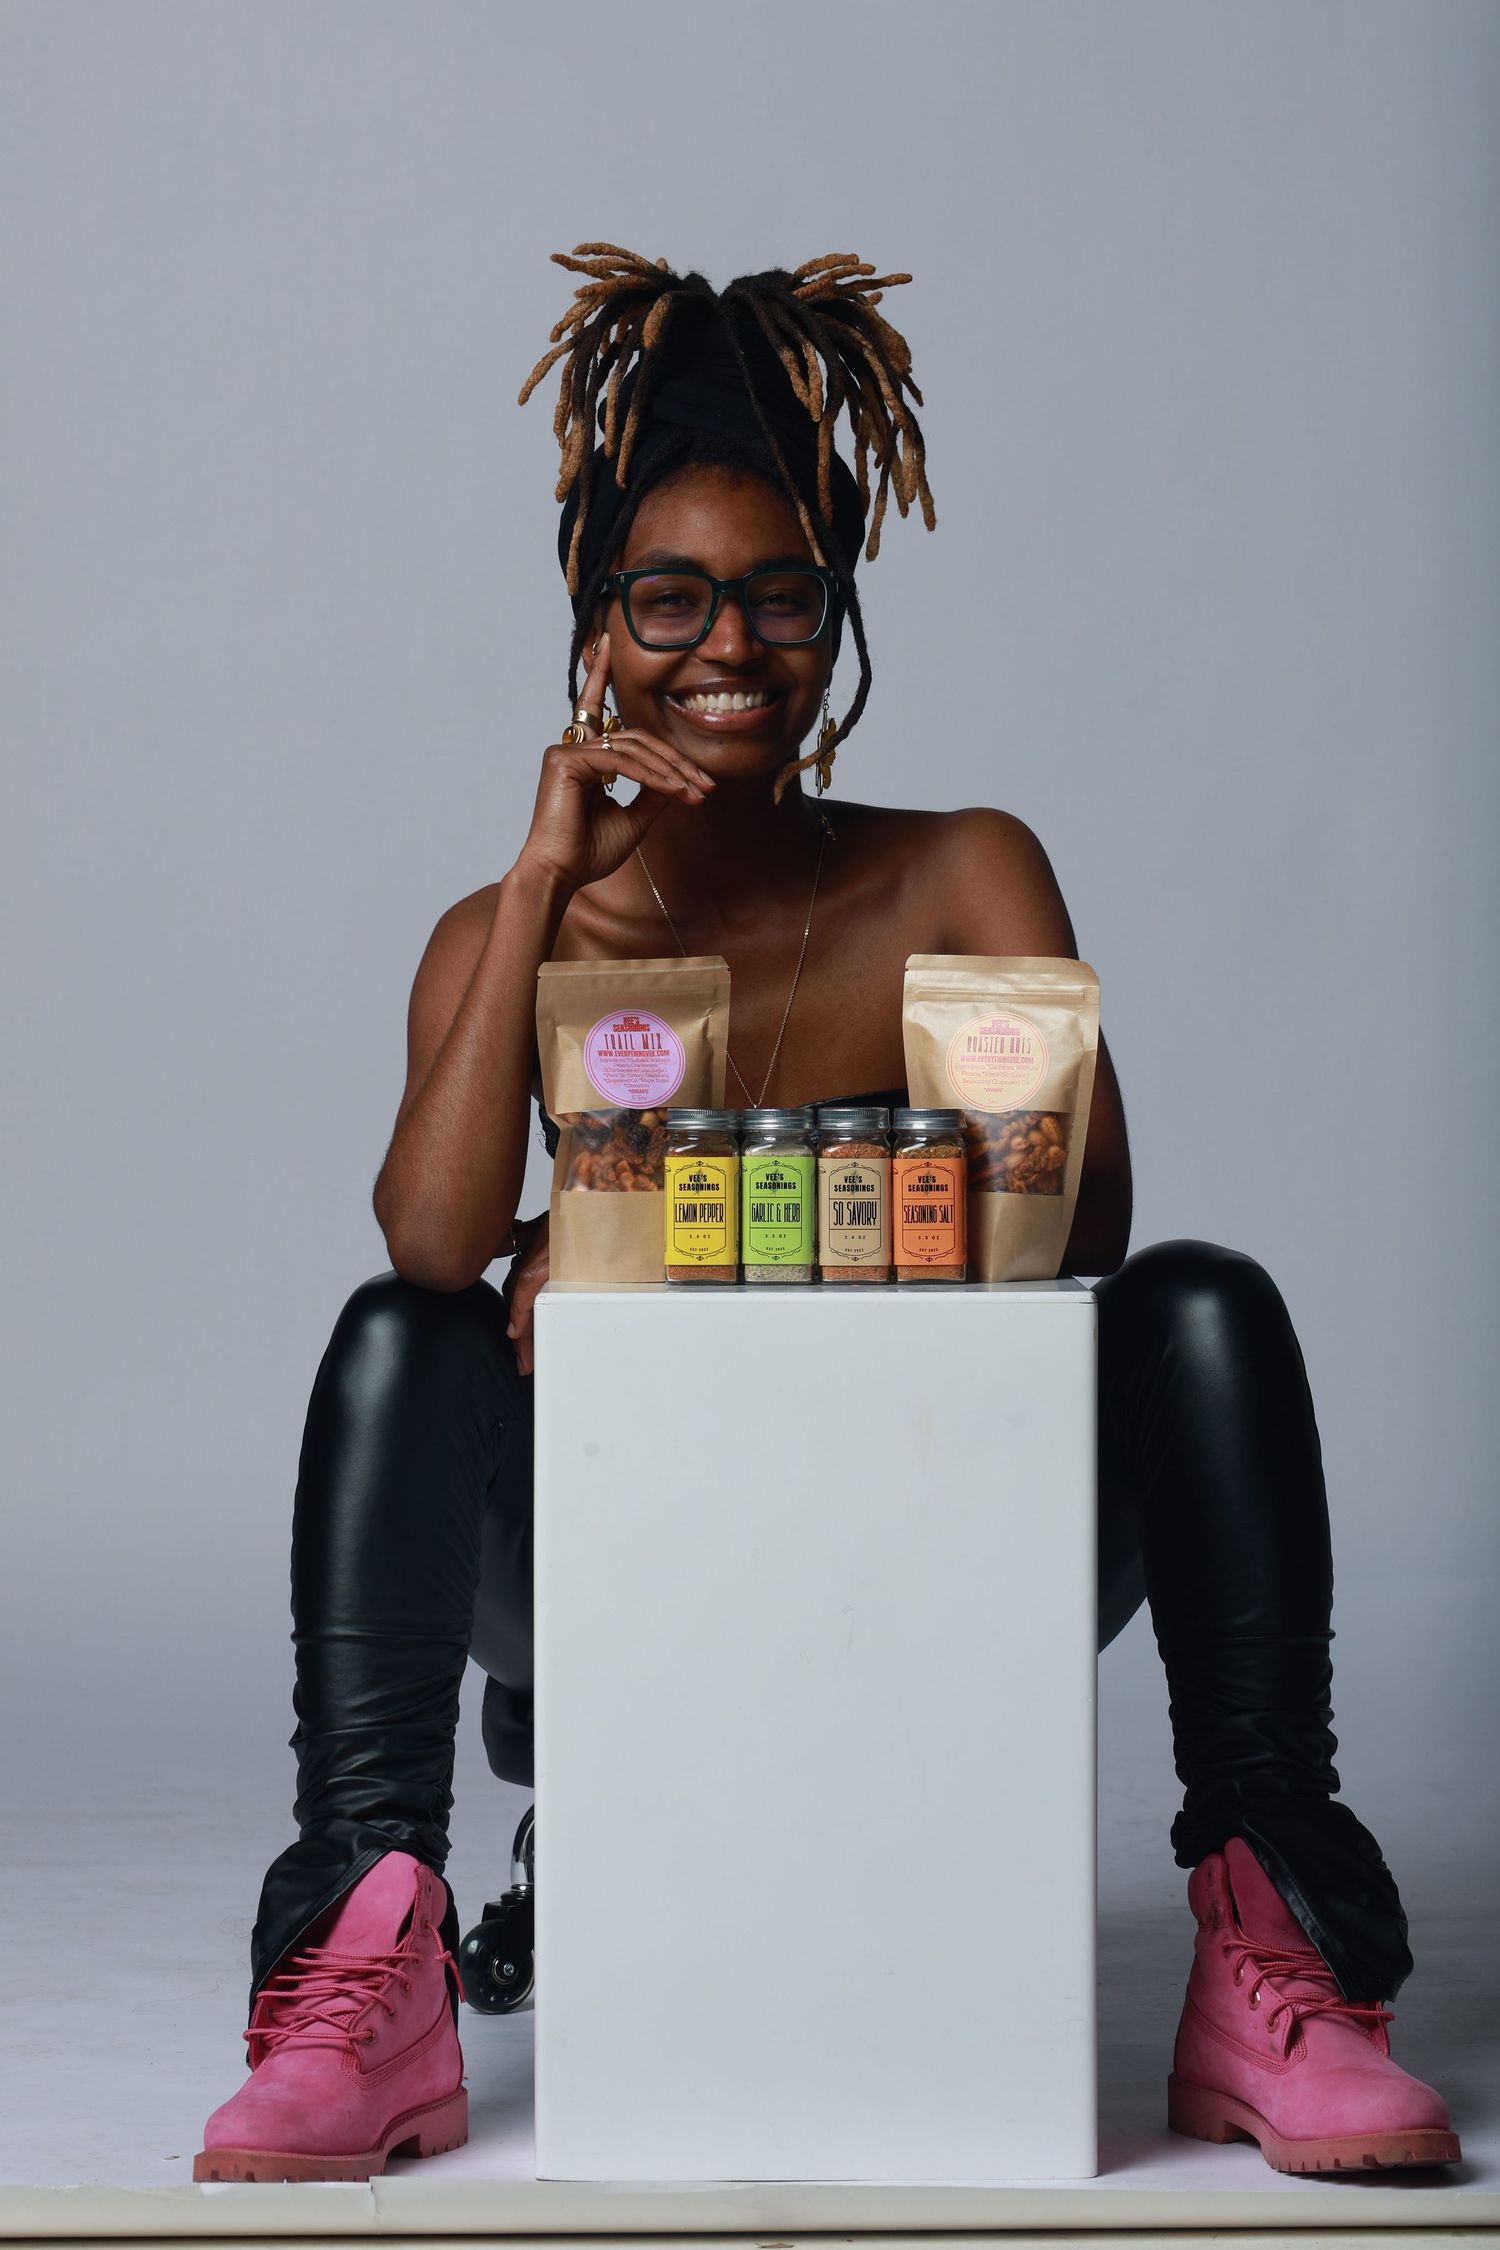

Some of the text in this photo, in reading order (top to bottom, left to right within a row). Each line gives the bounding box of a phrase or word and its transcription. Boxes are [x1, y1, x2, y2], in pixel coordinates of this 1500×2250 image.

[613, 1024, 650, 1032] SEASONINGS
[604, 1033, 662, 1050] TRAIL MIX
[967, 1036, 1031, 1054] ROASTED NUTS
[689, 1174, 707, 1182] VEE'S
[766, 1173, 784, 1181] VEE'S
[756, 1182, 796, 1190] SEASONINGS
[834, 1184, 875, 1192] SEASONINGS
[908, 1184, 949, 1192] SEASONINGS
[675, 1203, 724, 1223] LEMON PEPPER
[752, 1203, 800, 1223] GARLIC & HERB
[833, 1202, 877, 1226] SO SAVORY
[904, 1205, 954, 1224] SEASONING SALT
